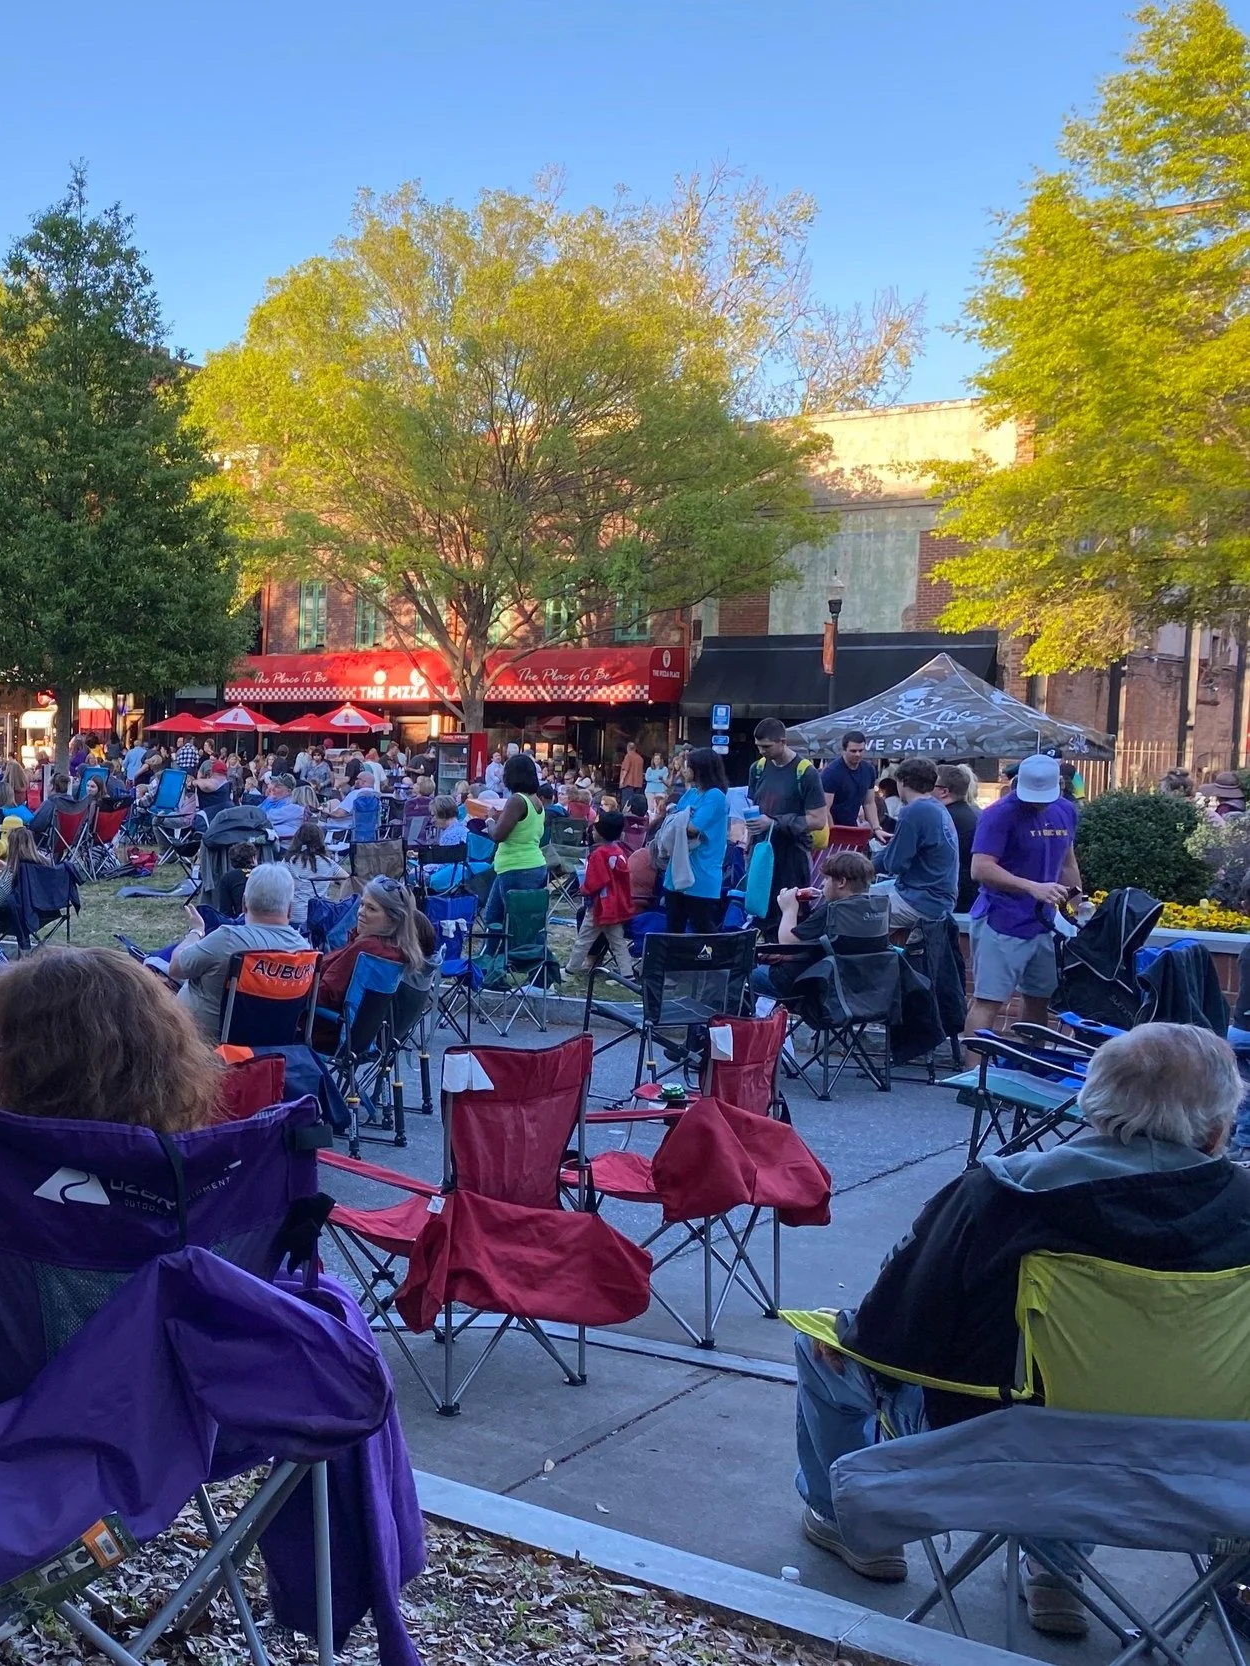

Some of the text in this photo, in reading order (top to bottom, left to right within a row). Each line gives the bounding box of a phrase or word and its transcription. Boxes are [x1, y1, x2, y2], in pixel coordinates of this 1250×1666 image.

[273, 671, 299, 684] Place
[302, 670, 311, 683] To
[314, 671, 327, 683] Be
[518, 667, 611, 682] The Place To Be
[359, 685, 462, 699] THE PIZZA PLA
[863, 737, 949, 750] VE SALTY
